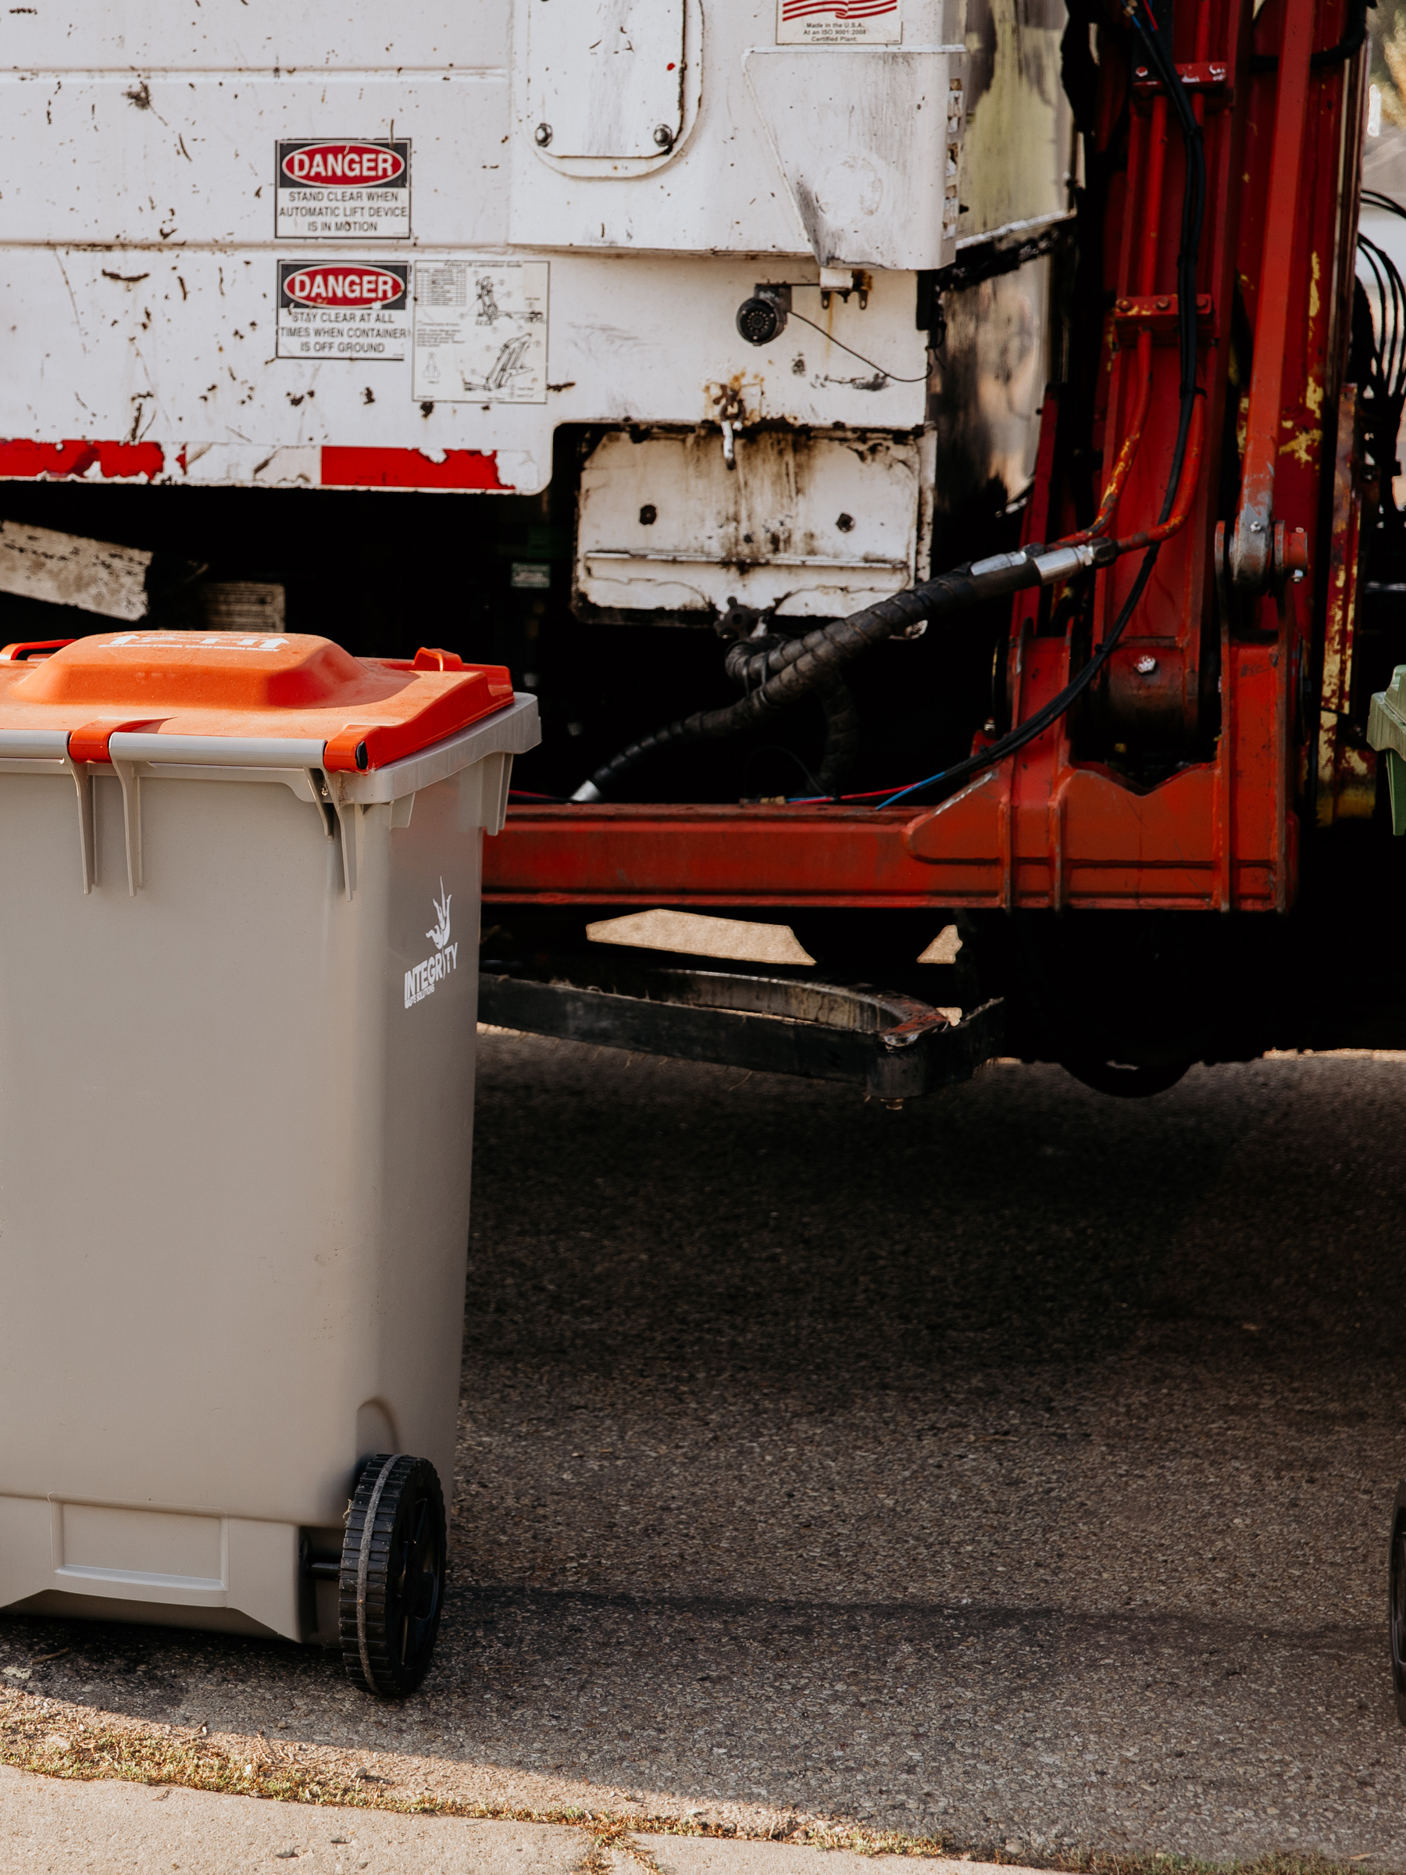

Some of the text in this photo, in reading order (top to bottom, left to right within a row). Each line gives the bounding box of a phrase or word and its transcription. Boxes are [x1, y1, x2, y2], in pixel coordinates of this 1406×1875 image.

[294, 153, 393, 177] DANGER
[288, 191, 399, 202] STAND CLEAR WHEN
[279, 206, 407, 217] AUTOMATIC LIFT DEVICE
[307, 221, 378, 232] IS IN MOTION
[295, 275, 393, 298] DANGER
[292, 312, 395, 324] STAY CLEAR AT ALL
[280, 327, 311, 337] TIMES
[314, 327, 344, 338] WHEN
[346, 328, 407, 339] CONTAINER
[300, 342, 385, 353] IS OFF GROUND
[404, 941, 458, 1001] INTEGRITY
